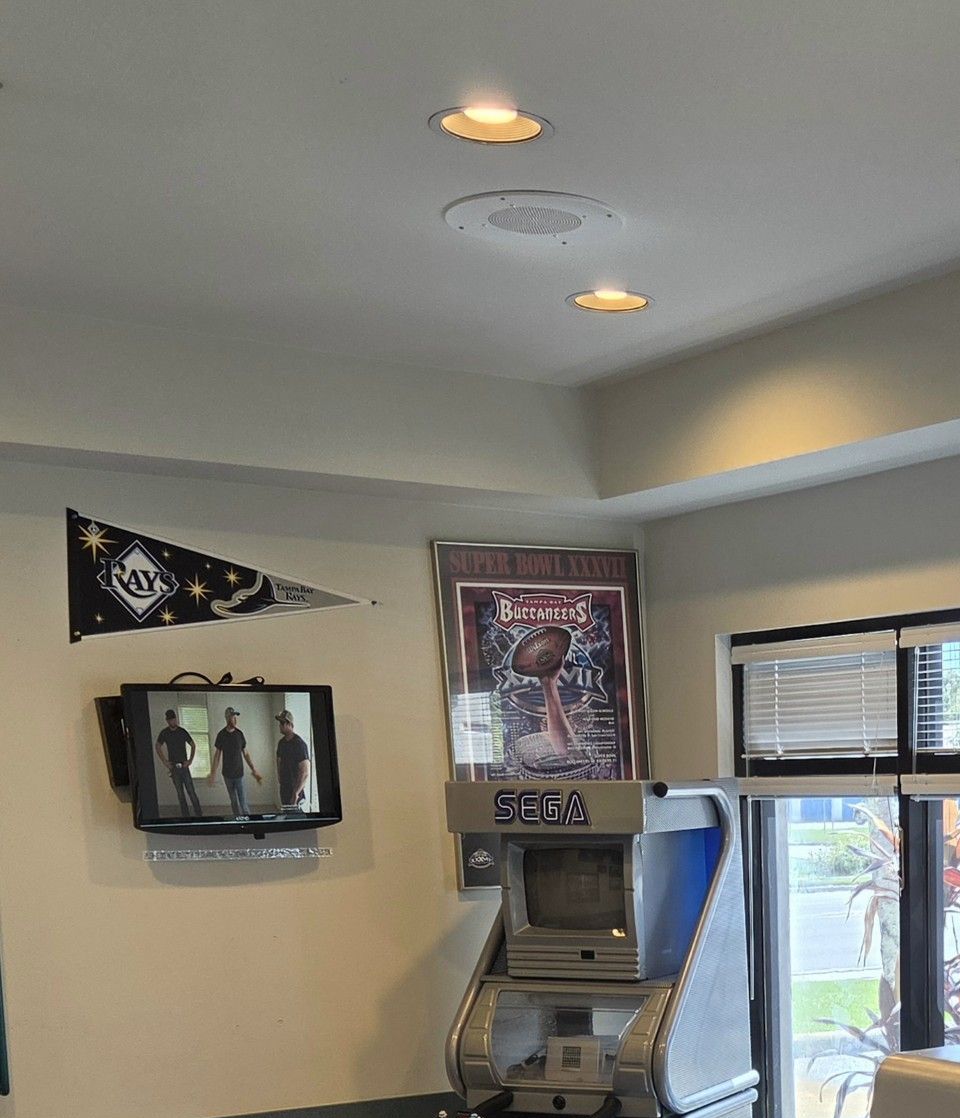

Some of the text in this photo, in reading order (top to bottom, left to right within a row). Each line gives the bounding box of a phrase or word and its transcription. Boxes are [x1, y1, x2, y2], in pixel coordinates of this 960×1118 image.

[101, 558, 178, 599] RAYS
[448, 550, 628, 579] SUPER BOWL XXXVII
[494, 789, 592, 826] SEGA
